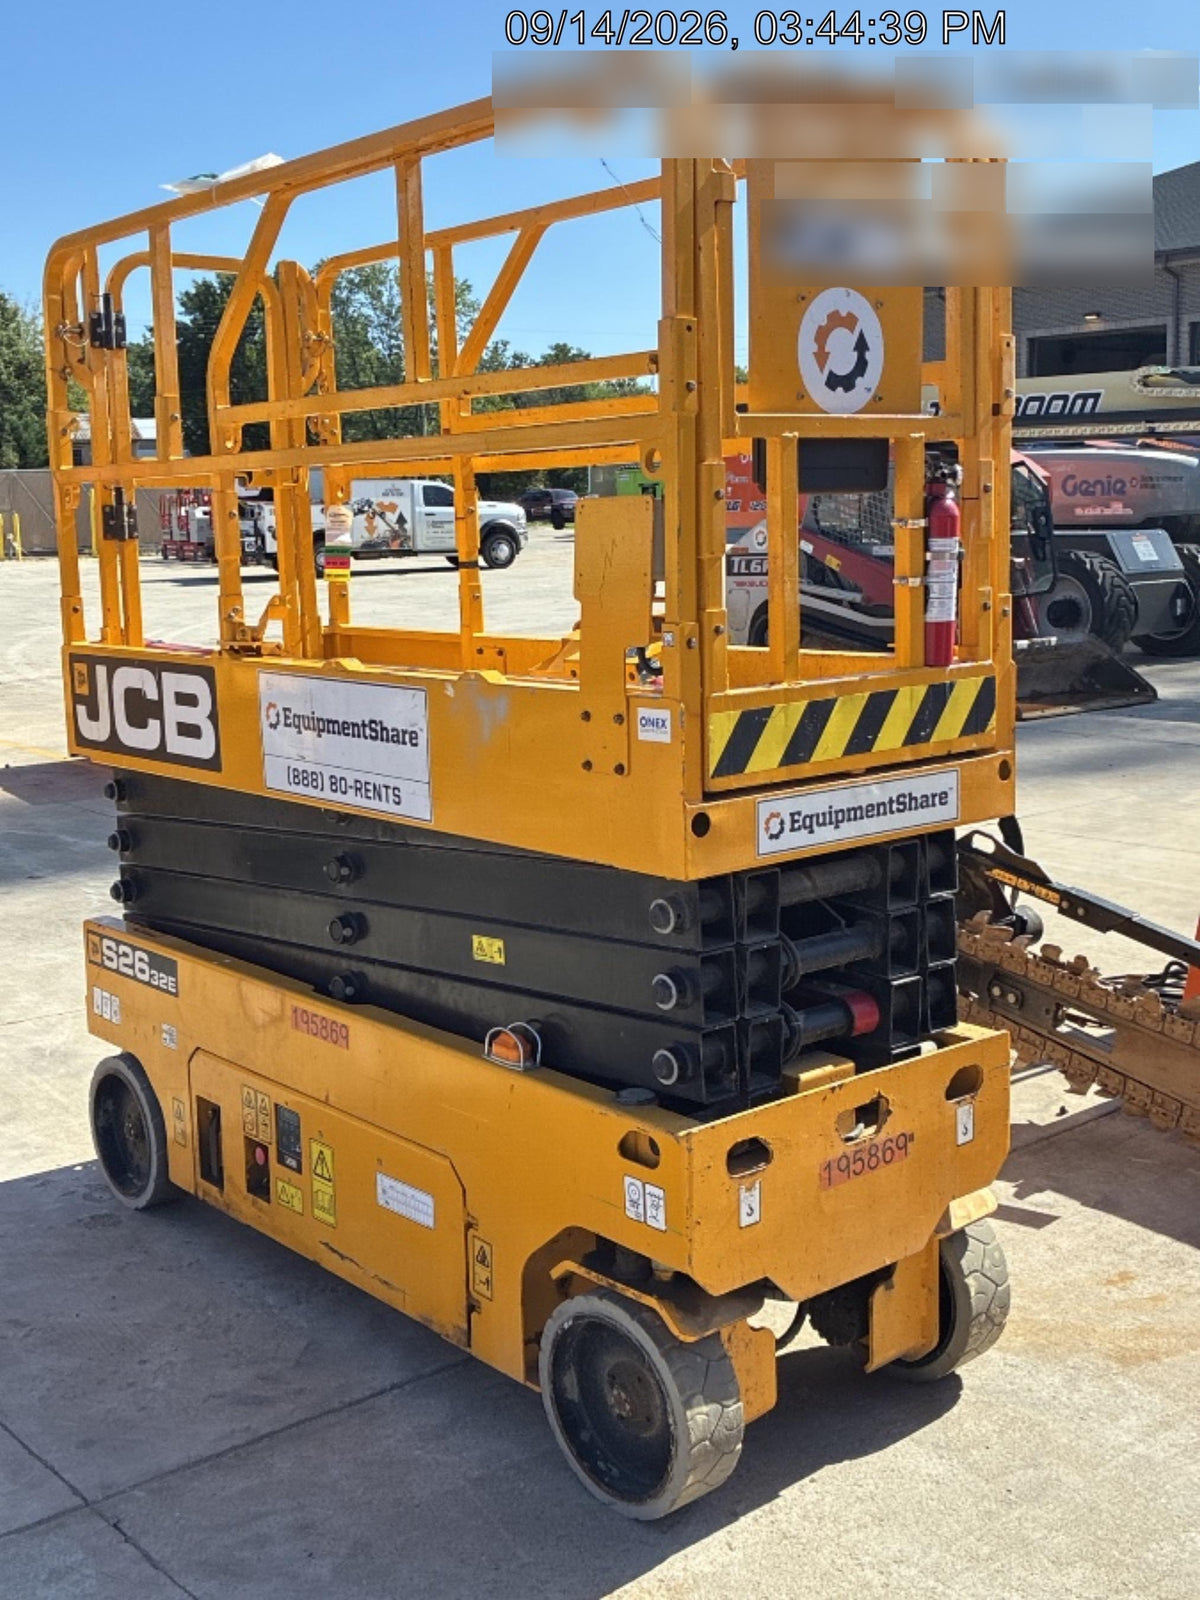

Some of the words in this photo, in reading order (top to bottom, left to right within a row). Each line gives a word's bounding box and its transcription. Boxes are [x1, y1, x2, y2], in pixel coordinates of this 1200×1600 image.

[1061, 474, 1127, 497] Genie
[76, 664, 216, 760] JCB
[282, 706, 419, 747] EquipmentShare
[640, 715, 667, 730] ONEX
[287, 765, 324, 792] (888)
[328, 774, 402, 806] 80-RENTS
[789, 789, 949, 834] EquipmentShare
[292, 1006, 349, 1050] 195869
